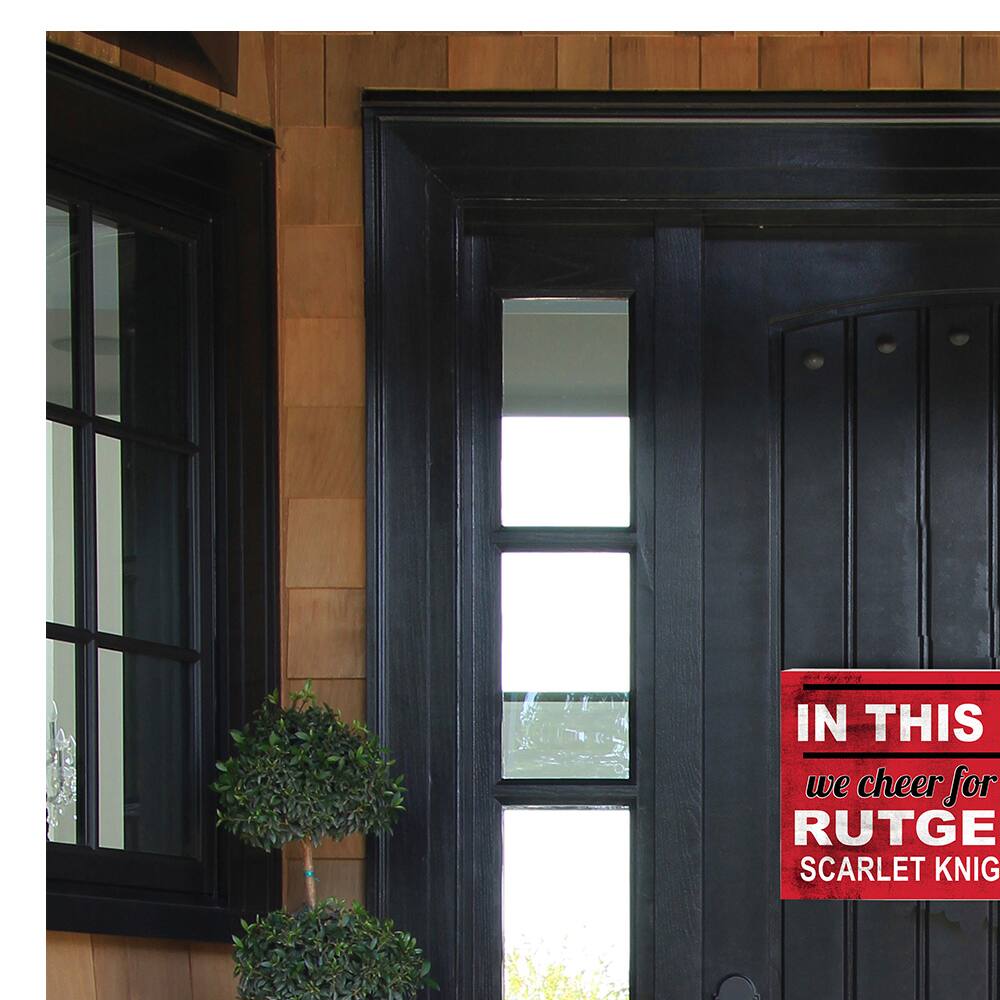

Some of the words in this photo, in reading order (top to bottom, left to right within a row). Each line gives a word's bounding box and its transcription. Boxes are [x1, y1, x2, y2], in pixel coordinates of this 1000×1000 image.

[797, 703, 847, 742] IN
[865, 703, 984, 743] THIS
[805, 773, 850, 798] we
[857, 767, 943, 798] cheer
[942, 765, 998, 808] for
[800, 855, 926, 882] SCARLET
